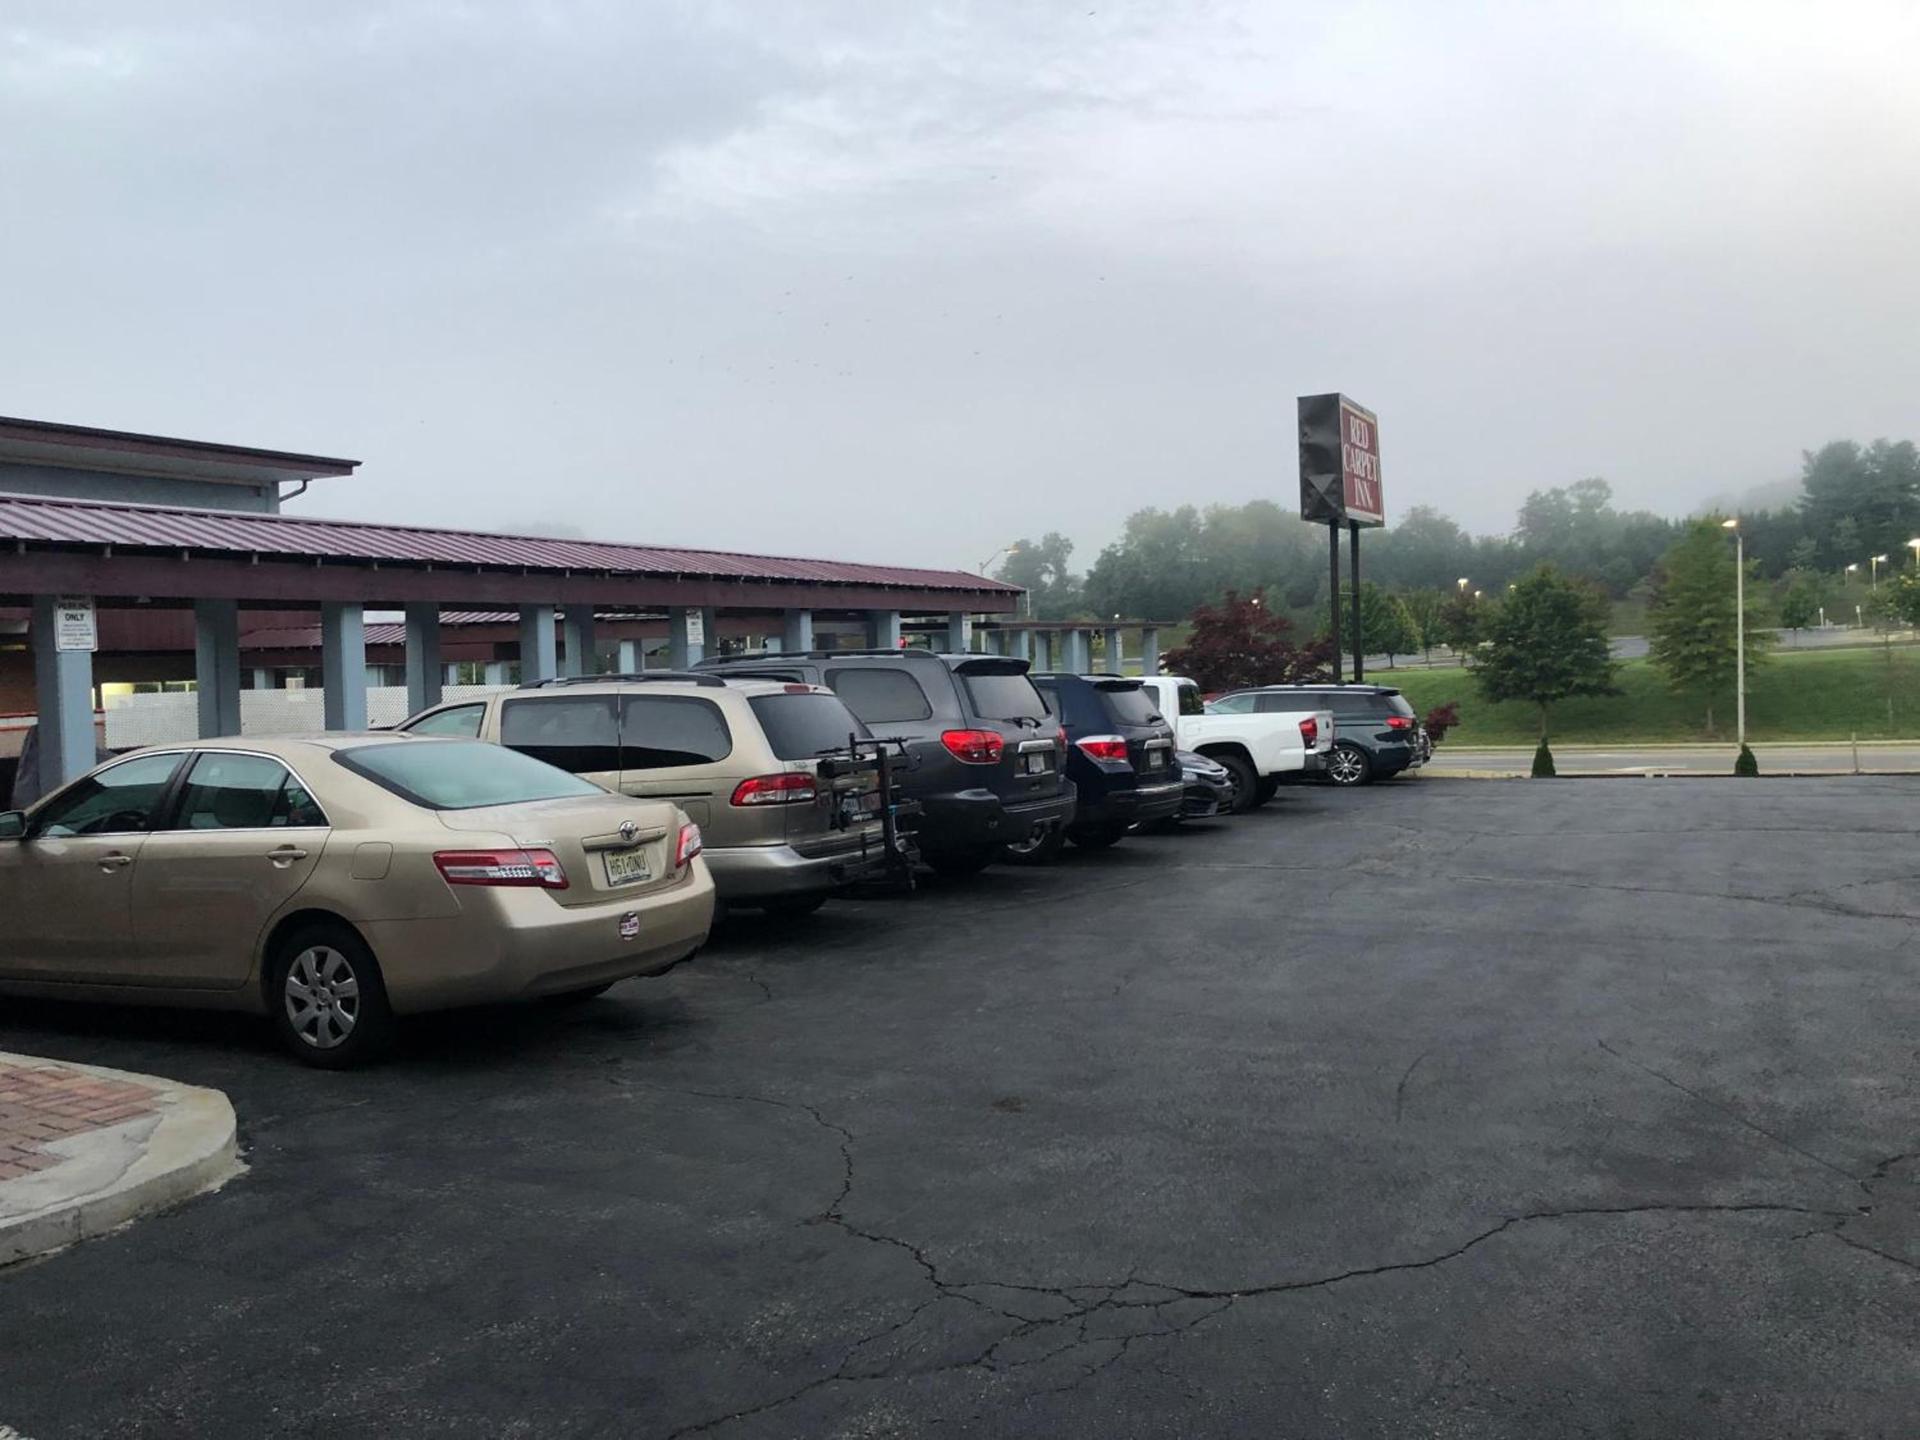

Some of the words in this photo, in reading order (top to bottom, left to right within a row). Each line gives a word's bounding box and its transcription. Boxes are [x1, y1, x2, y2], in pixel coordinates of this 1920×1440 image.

[1350, 415, 1369, 449] RED
[1343, 443, 1378, 482] CARPET
[1354, 477, 1373, 509] INN
[65, 613, 84, 621] ONLY
